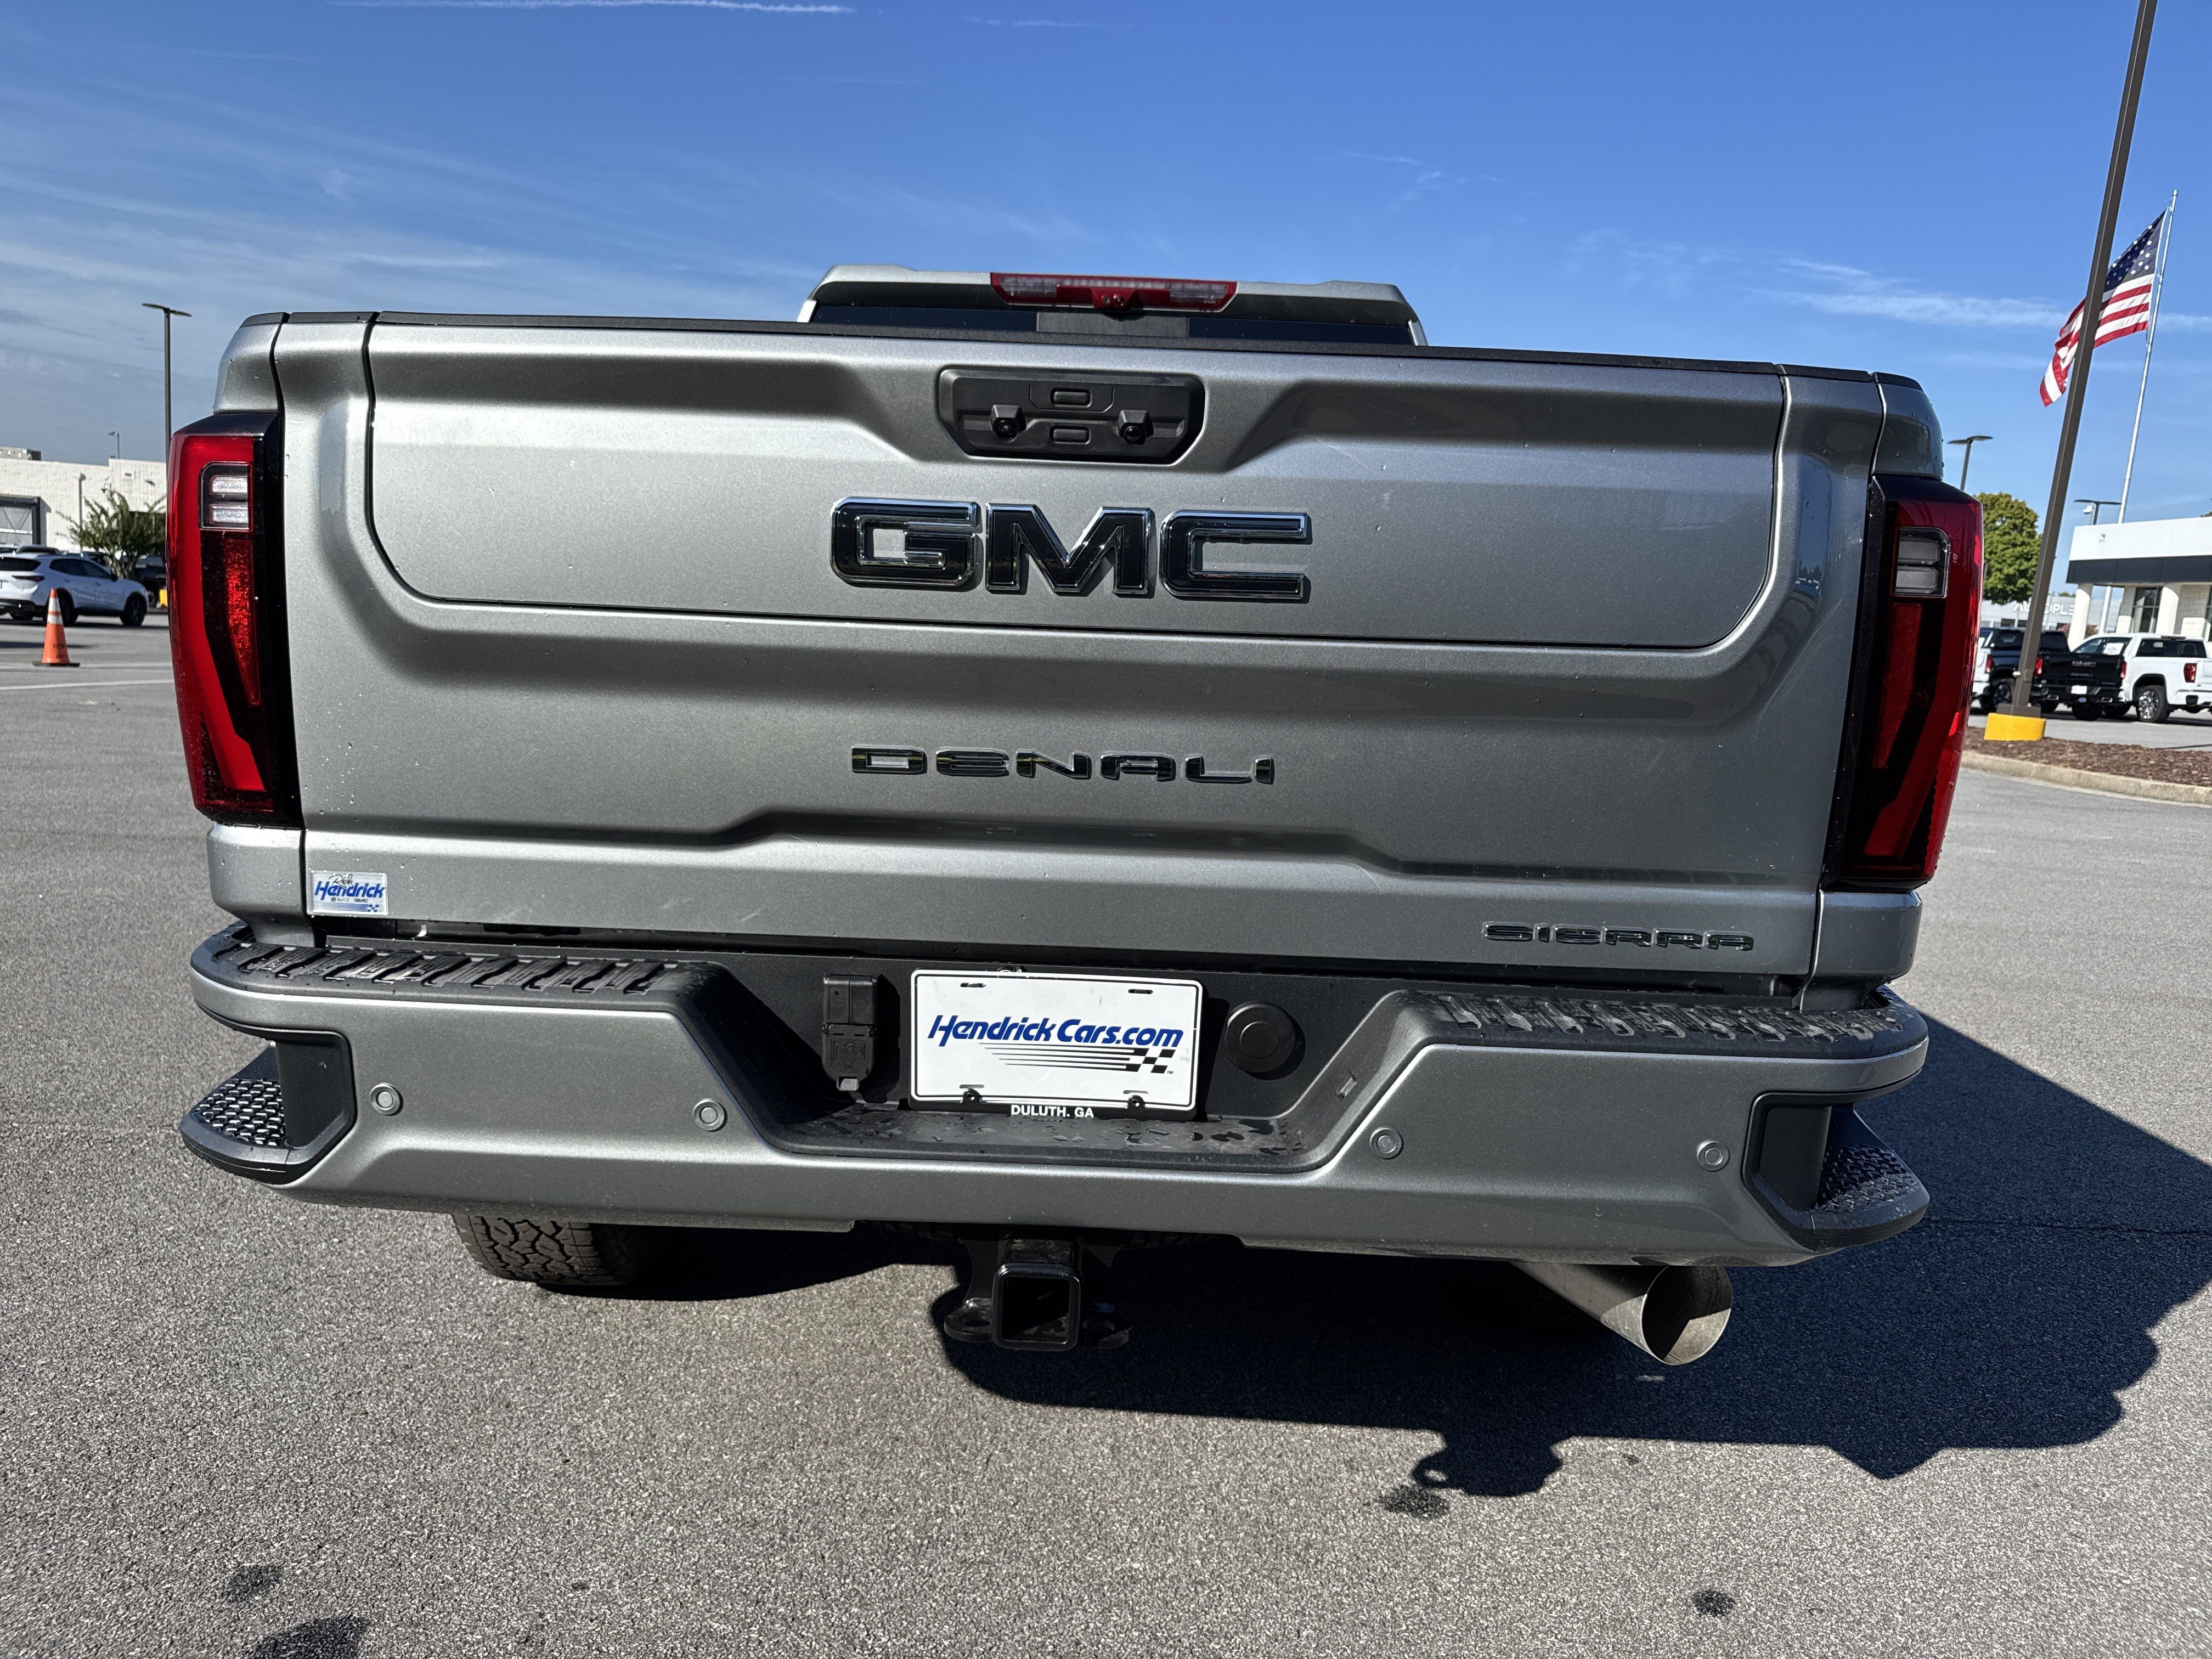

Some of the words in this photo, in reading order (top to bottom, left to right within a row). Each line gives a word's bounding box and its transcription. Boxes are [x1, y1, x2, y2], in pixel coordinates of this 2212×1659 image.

[830, 497, 1308, 600] GMC
[2013, 600, 2074, 616] AUOPLE
[851, 745, 1273, 784] DENALI
[314, 881, 386, 900] Hendrick
[329, 874, 353, 888] Rick
[1482, 922, 1753, 951] SIERRA
[1074, 1107, 1094, 1118] GA
